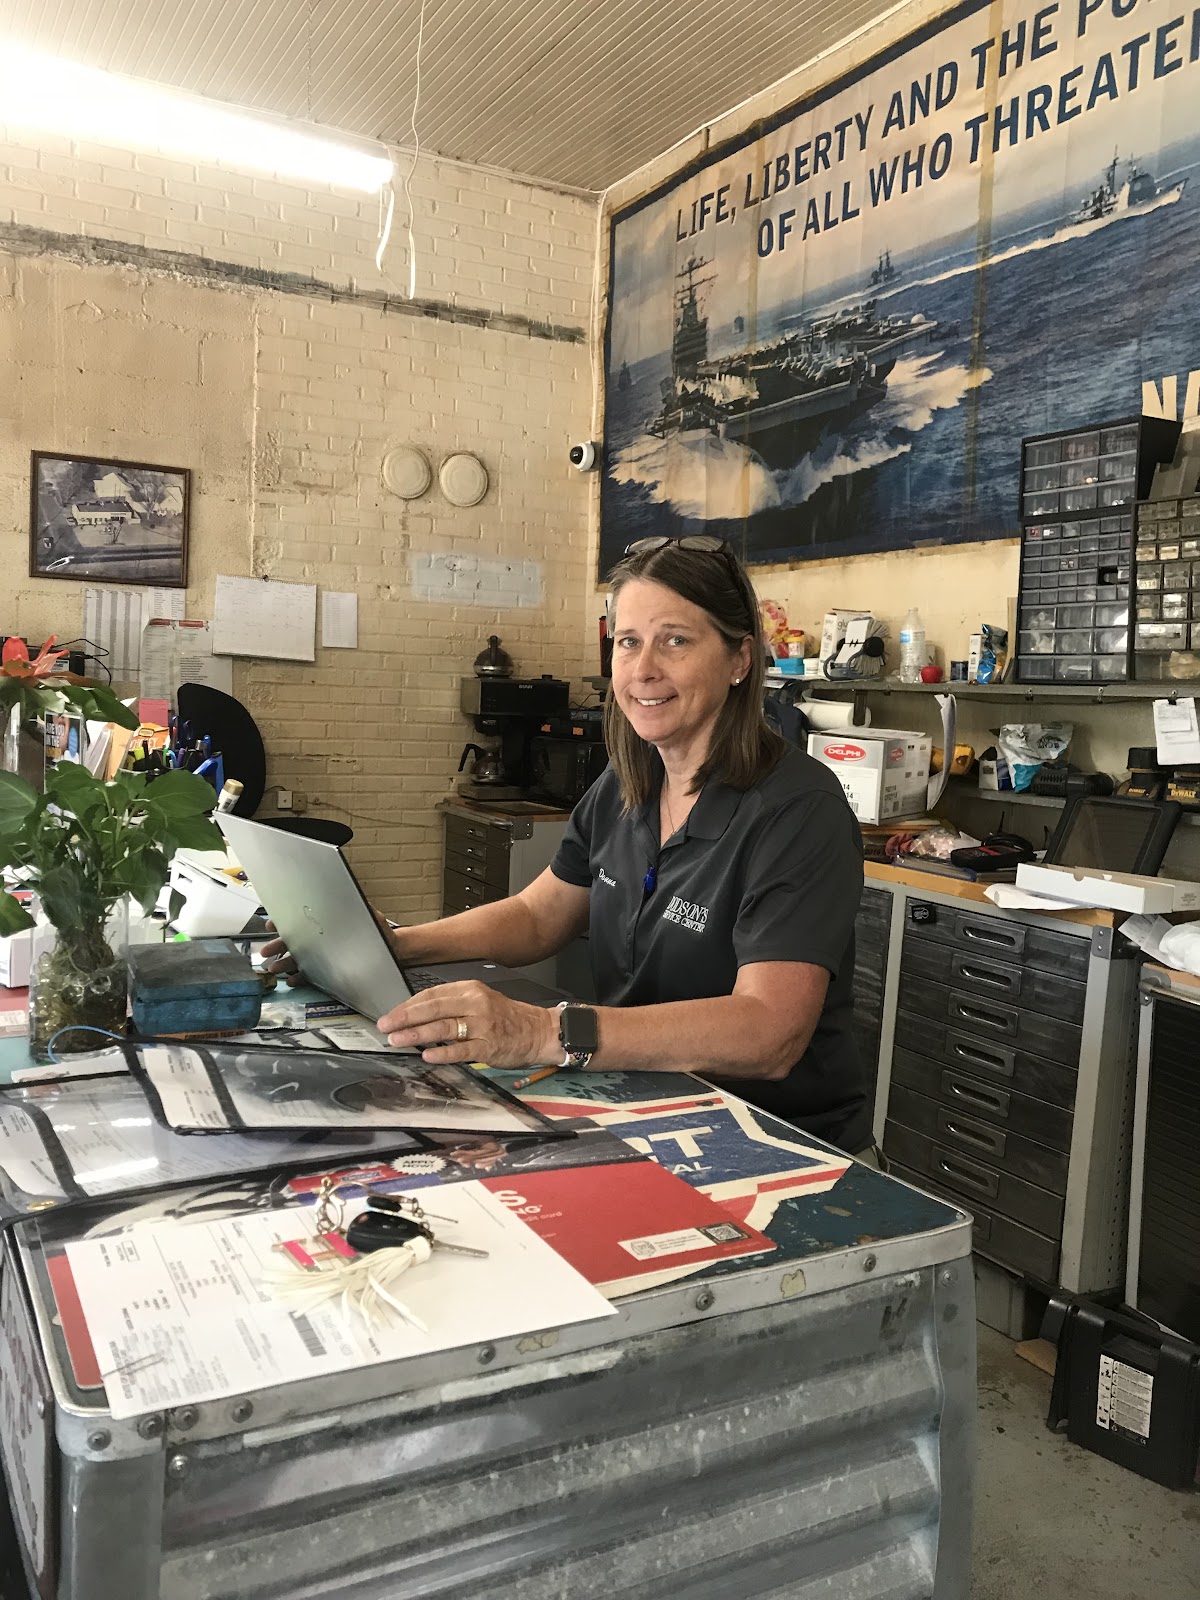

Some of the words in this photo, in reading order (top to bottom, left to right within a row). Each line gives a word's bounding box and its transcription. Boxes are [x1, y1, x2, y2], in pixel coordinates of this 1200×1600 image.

[676, 184, 736, 243] LIFE,
[743, 104, 874, 210] LIBERTY
[881, 61, 959, 138] AND
[971, 3, 1059, 90] THE
[757, 209, 796, 258] OF
[802, 181, 860, 241] ALL
[869, 132, 953, 208] WHO
[827, 748, 861, 757] DELPHI
